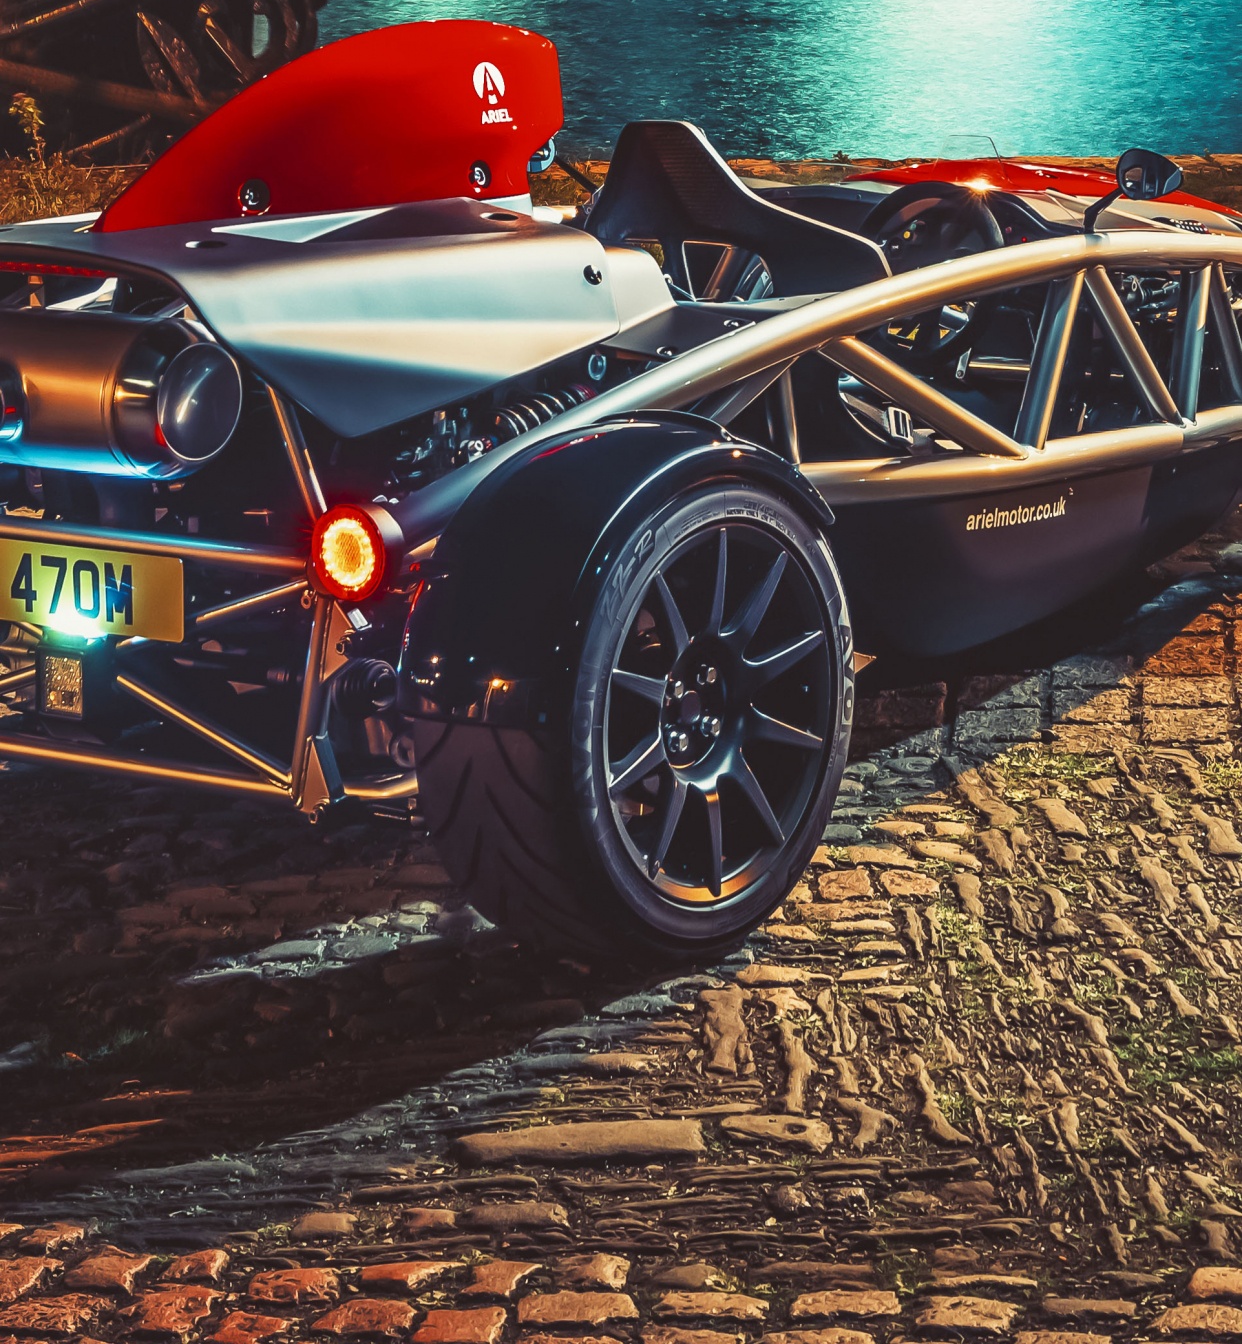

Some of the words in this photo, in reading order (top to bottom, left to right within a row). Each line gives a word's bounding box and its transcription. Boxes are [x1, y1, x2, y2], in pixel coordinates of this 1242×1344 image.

[482, 108, 513, 125] ARIEL
[965, 495, 1067, 531] arielmotor.co.uk
[10, 552, 134, 626] 470M
